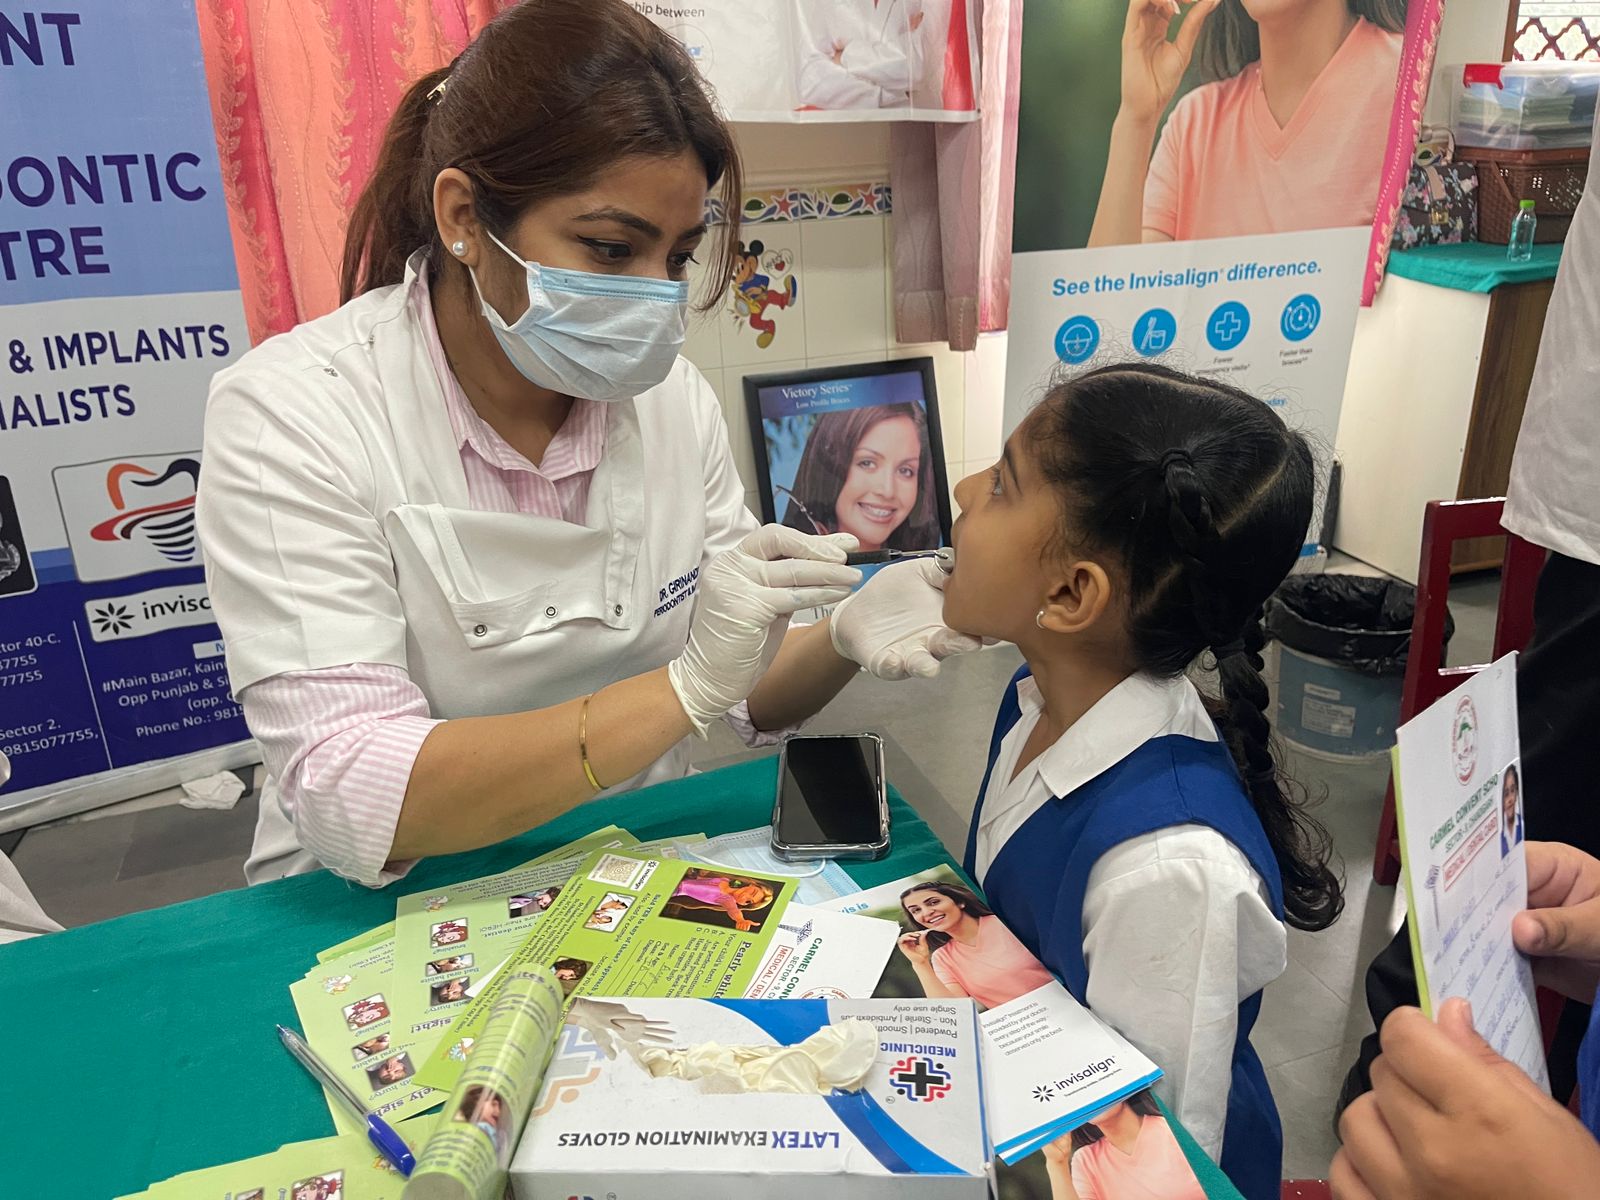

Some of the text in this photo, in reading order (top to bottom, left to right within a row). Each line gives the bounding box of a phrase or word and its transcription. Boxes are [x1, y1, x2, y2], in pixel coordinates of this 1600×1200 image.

[656, 5, 705, 18] between
[0, 152, 207, 208] ONTIC
[1052, 278, 1090, 297] See
[1095, 275, 1124, 293] the
[1226, 260, 1322, 282] difference.
[8, 324, 230, 374] & IMPLANTS
[782, 387, 817, 399] Victory
[102, 676, 148, 693] #Main
[151, 667, 191, 684] Bazar,
[118, 693, 148, 707] Opp
[151, 681, 199, 701] Punjab
[202, 679, 214, 690] &
[136, 722, 180, 737] Phone
[683, 936, 697, 949] Need
[692, 938, 705, 950] Have
[700, 939, 713, 951] Just
[709, 940, 720, 950] Are
[723, 932, 738, 946] Your
[692, 952, 705, 965] need
[711, 947, 730, 967] child's
[725, 941, 753, 971] Pearly
[762, 947, 789, 979] MEDICAL
[798, 937, 823, 976] CARMEL
[462, 967, 478, 975] Bad
[680, 965, 697, 983] proper
[777, 955, 800, 981] SECTOR
[419, 974, 444, 984] habits
[930, 1006, 957, 1015] Single
[409, 1017, 451, 1033] sight!
[905, 1015, 957, 1026] Non Sterile
[1017, 1014, 1031, 1022] your
[1034, 1015, 1047, 1024] way
[914, 1025, 958, 1039] Powdered
[1028, 1036, 1042, 1045] only
[1039, 1032, 1051, 1040] the
[997, 1035, 1024, 1049] because
[1022, 1030, 1035, 1039] your
[880, 1042, 957, 1058] MEDICLINIC
[557, 1130, 839, 1149] LATEX EXAMINATION GLOVES
